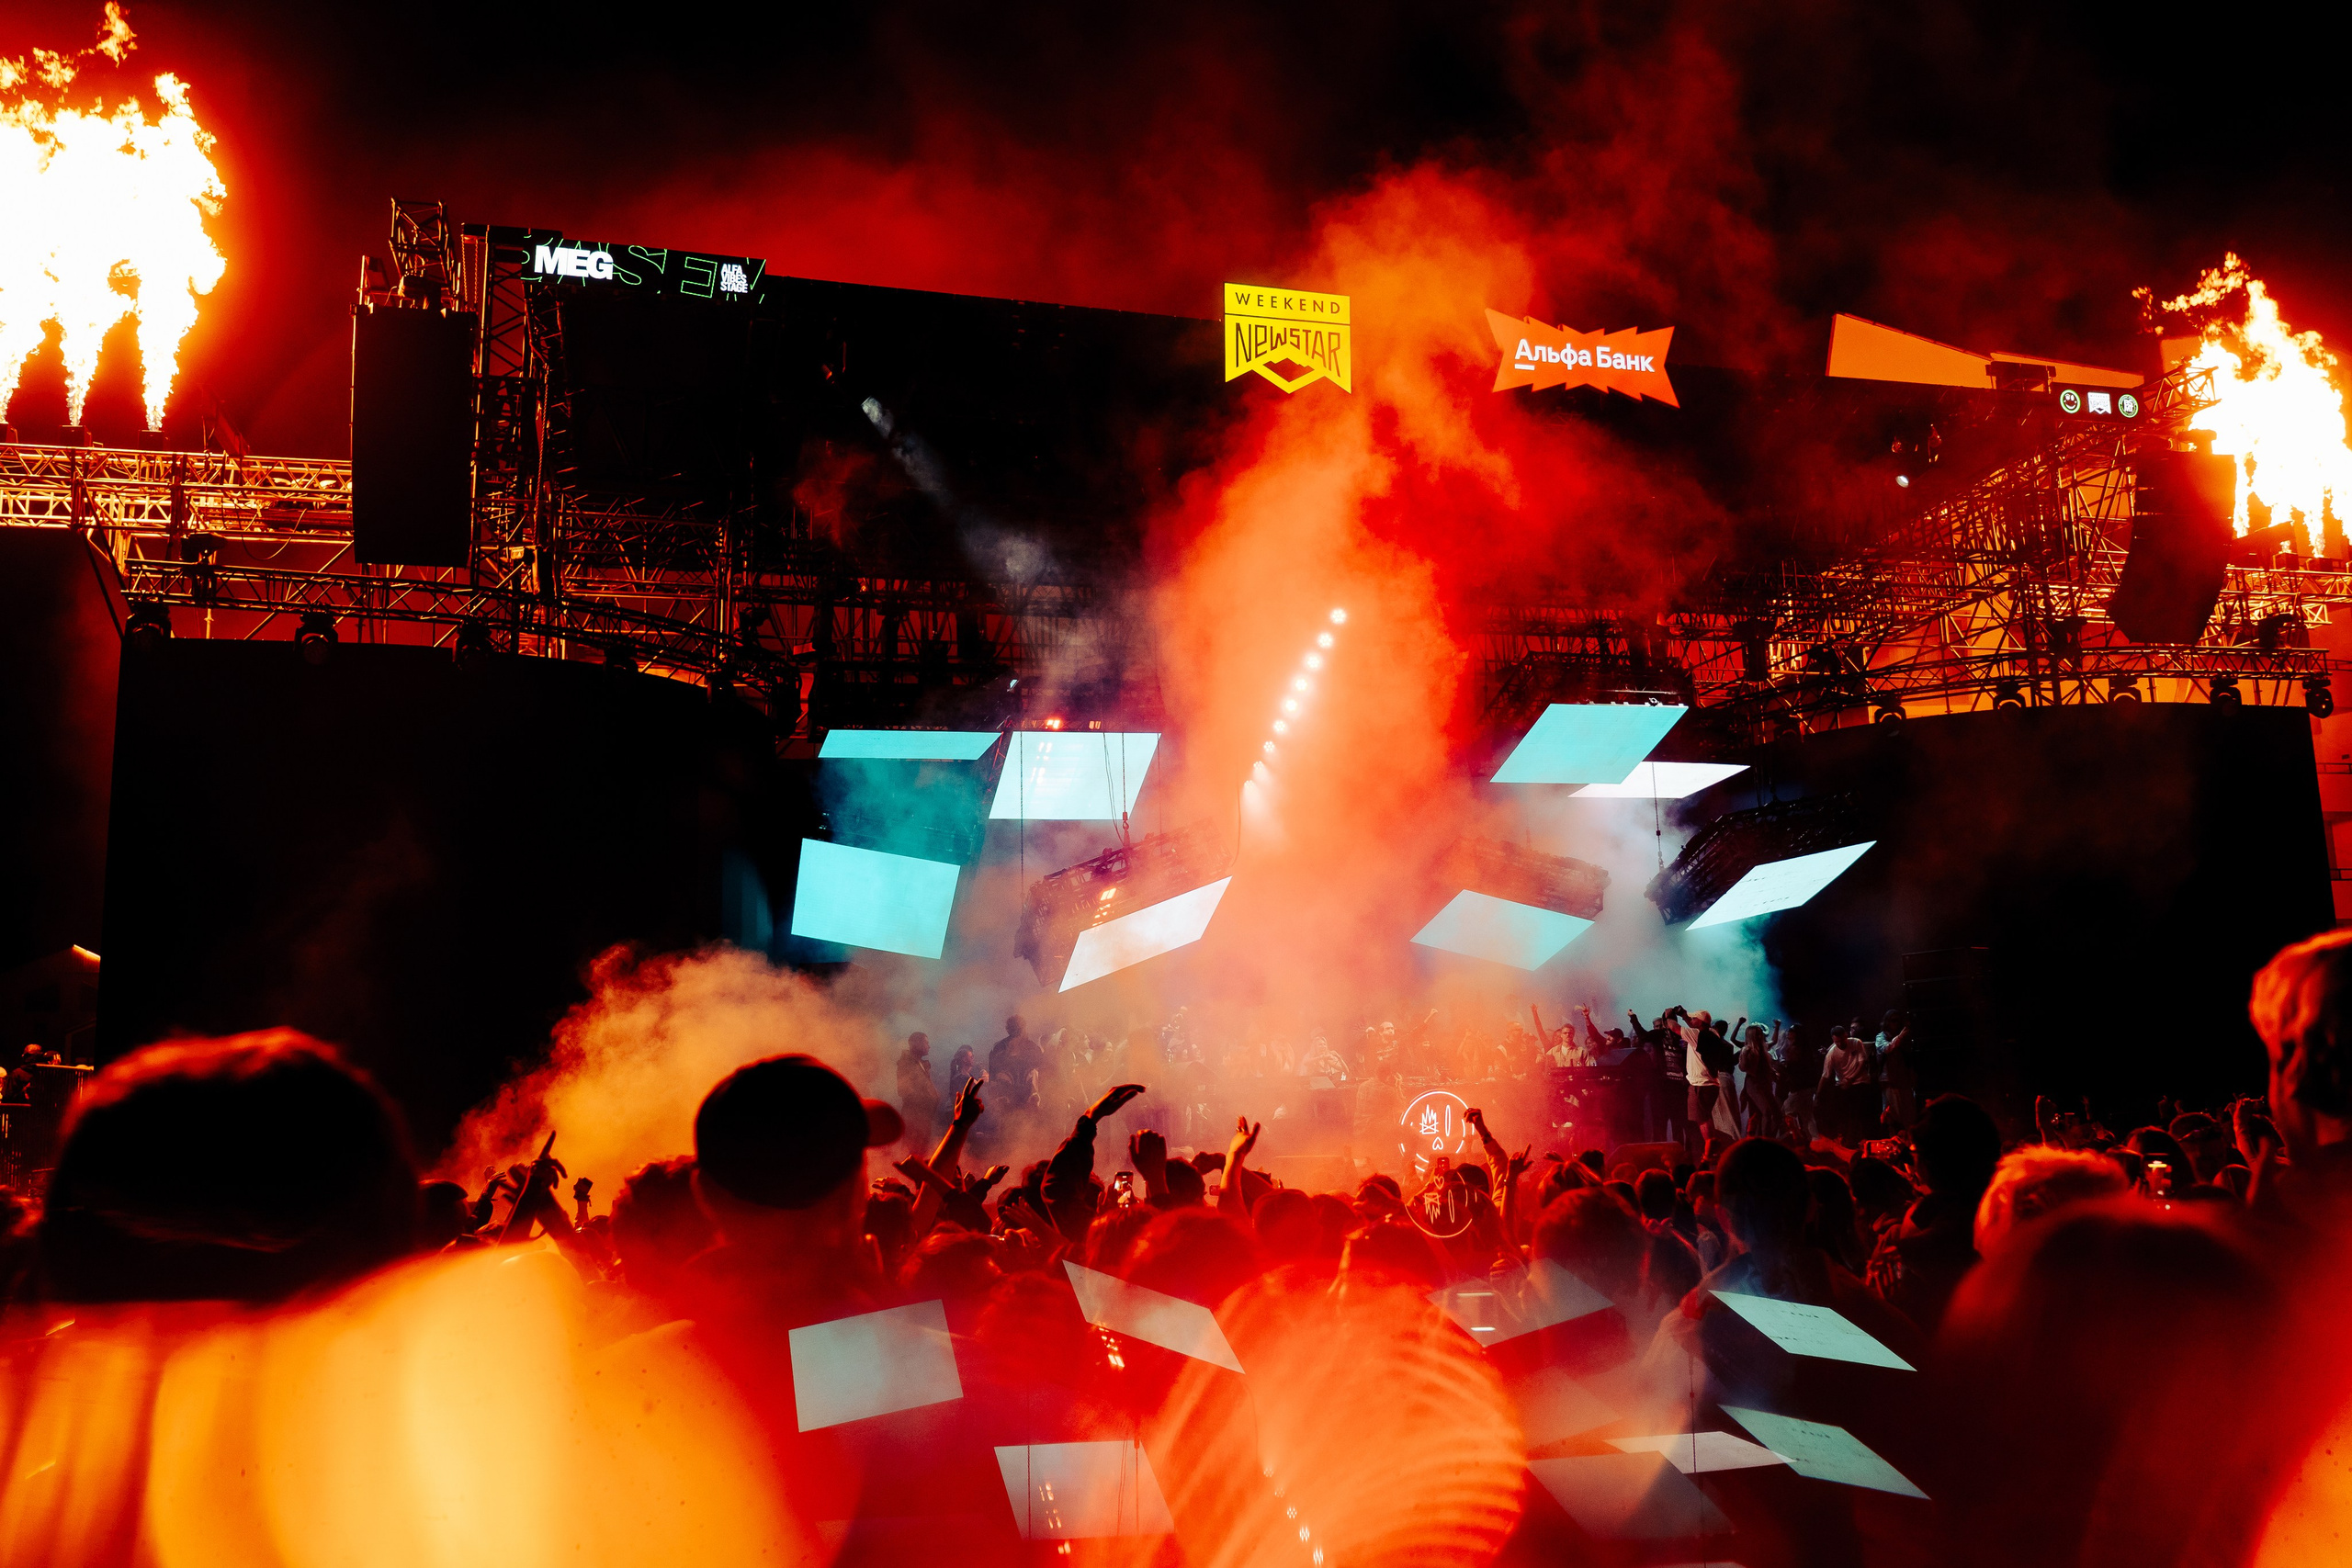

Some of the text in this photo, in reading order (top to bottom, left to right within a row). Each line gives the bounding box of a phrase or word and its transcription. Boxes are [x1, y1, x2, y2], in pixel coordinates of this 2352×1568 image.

[534, 244, 614, 280] MEG
[721, 263, 743, 275] ALFA
[720, 281, 749, 293] STAGE
[721, 273, 747, 284] VIBES
[1235, 291, 1340, 314] WEEKEND
[1514, 338, 1656, 373] Альфа Банк
